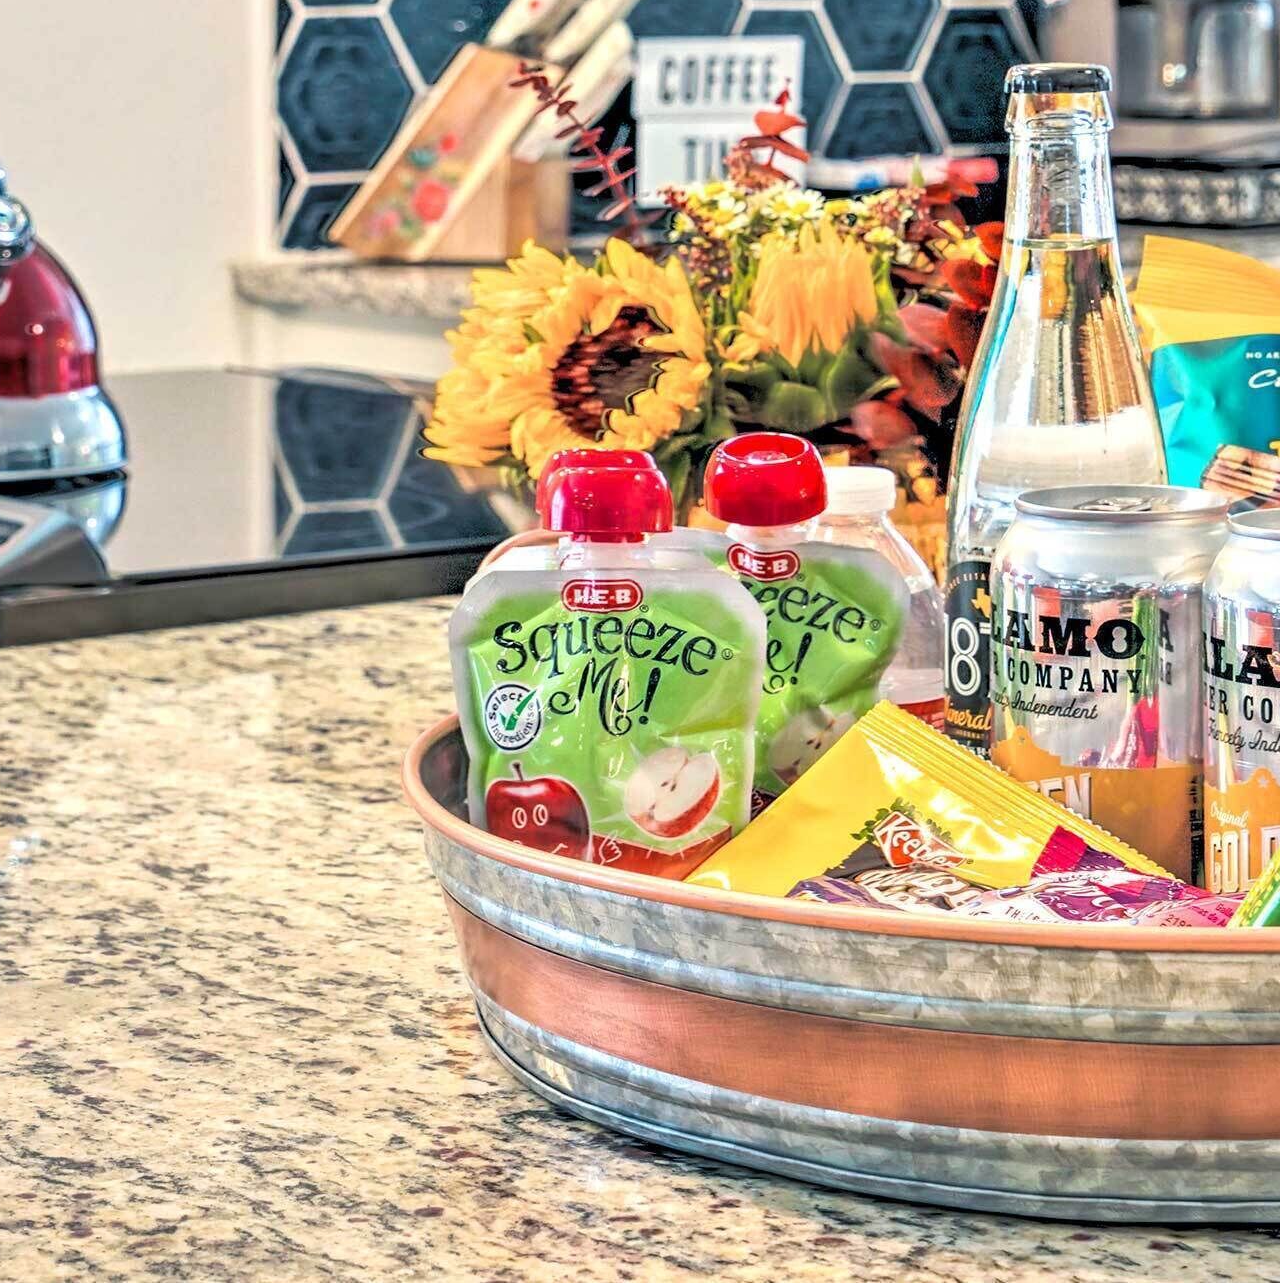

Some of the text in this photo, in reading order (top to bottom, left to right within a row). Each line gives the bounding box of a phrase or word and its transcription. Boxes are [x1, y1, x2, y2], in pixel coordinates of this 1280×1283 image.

[658, 56, 775, 104] COFFEE
[685, 137, 728, 182] TI
[1246, 351, 1261, 360] NO
[493, 616, 717, 679] Squeeze
[763, 621, 813, 695] e!
[1007, 655, 1144, 694] COMPANY
[489, 692, 524, 721] Select
[548, 658, 662, 737] Me!
[1011, 690, 1099, 720] Independent
[1210, 801, 1248, 828] Original
